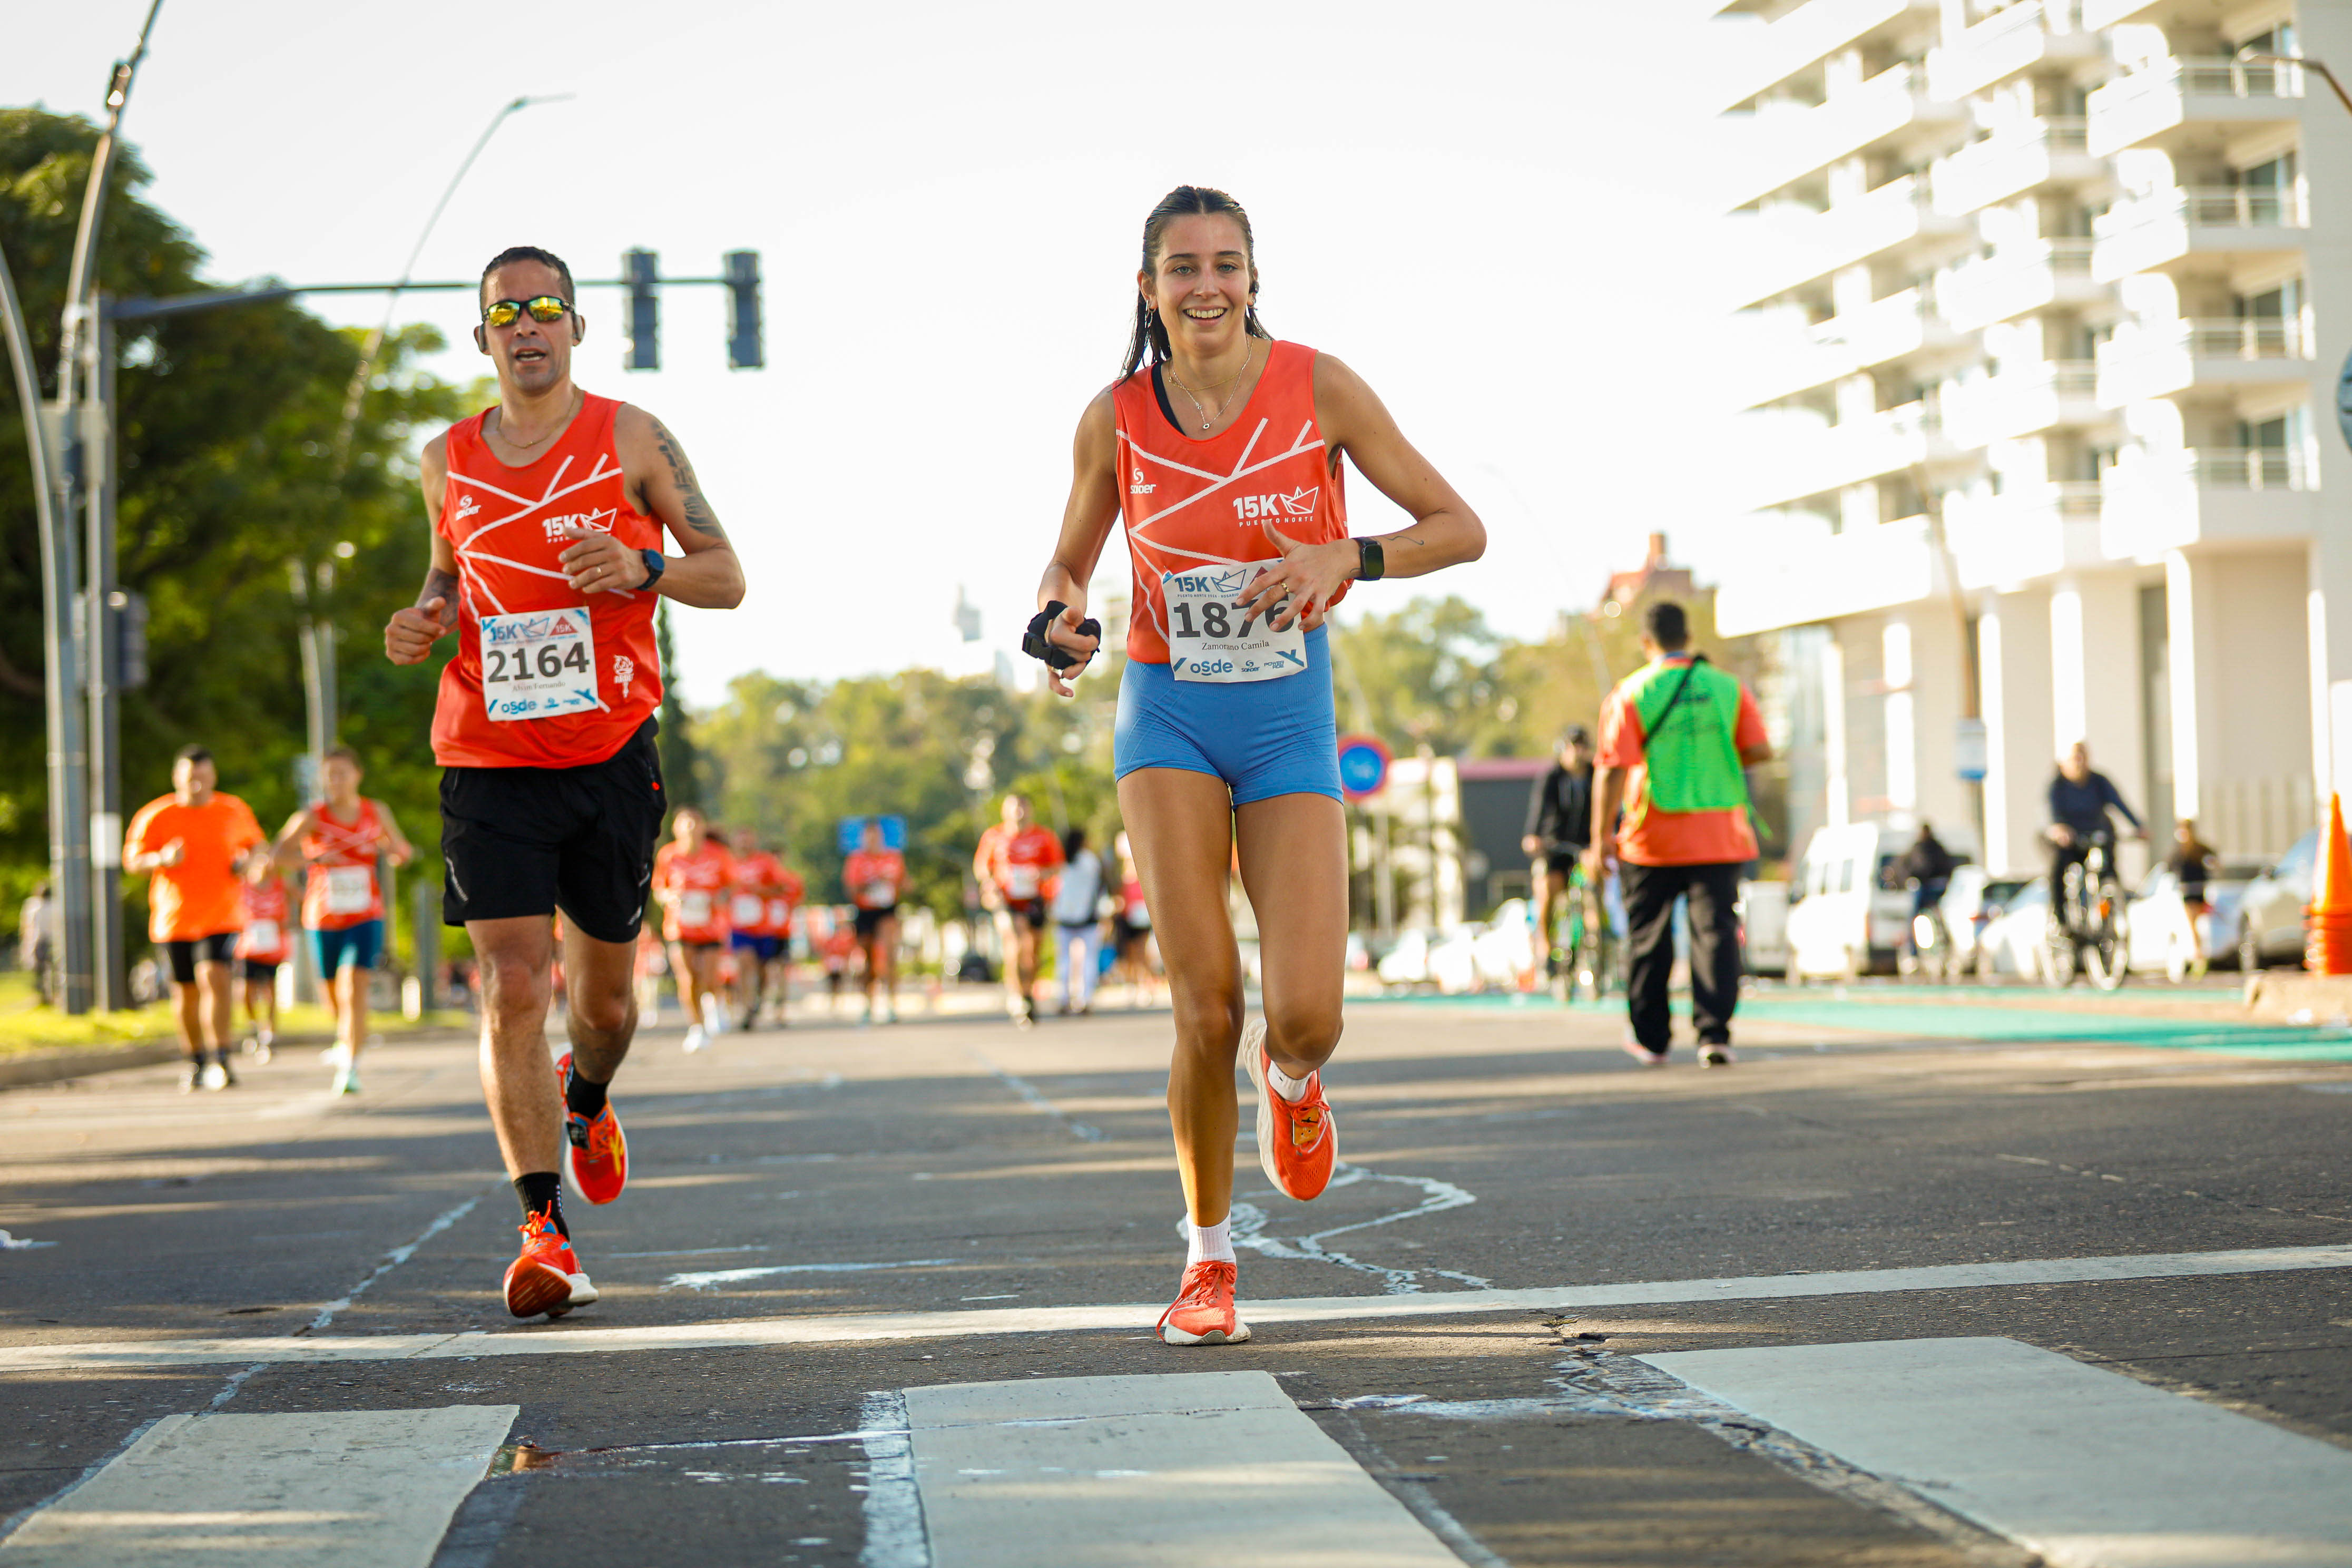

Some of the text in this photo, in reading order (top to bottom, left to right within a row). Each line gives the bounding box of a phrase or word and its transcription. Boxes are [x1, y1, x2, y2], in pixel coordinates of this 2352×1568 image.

[1233, 494, 1279, 519] 15K
[542, 513, 579, 537] 15K
[1174, 576, 1210, 592] 15K
[1173, 594, 1295, 638] 1876
[489, 624, 518, 641] 15K
[1241, 640, 1269, 649] Camila
[487, 642, 590, 682] 2164
[1190, 659, 1233, 674] osde
[534, 681, 566, 690] Fernando
[502, 699, 537, 713] osde
